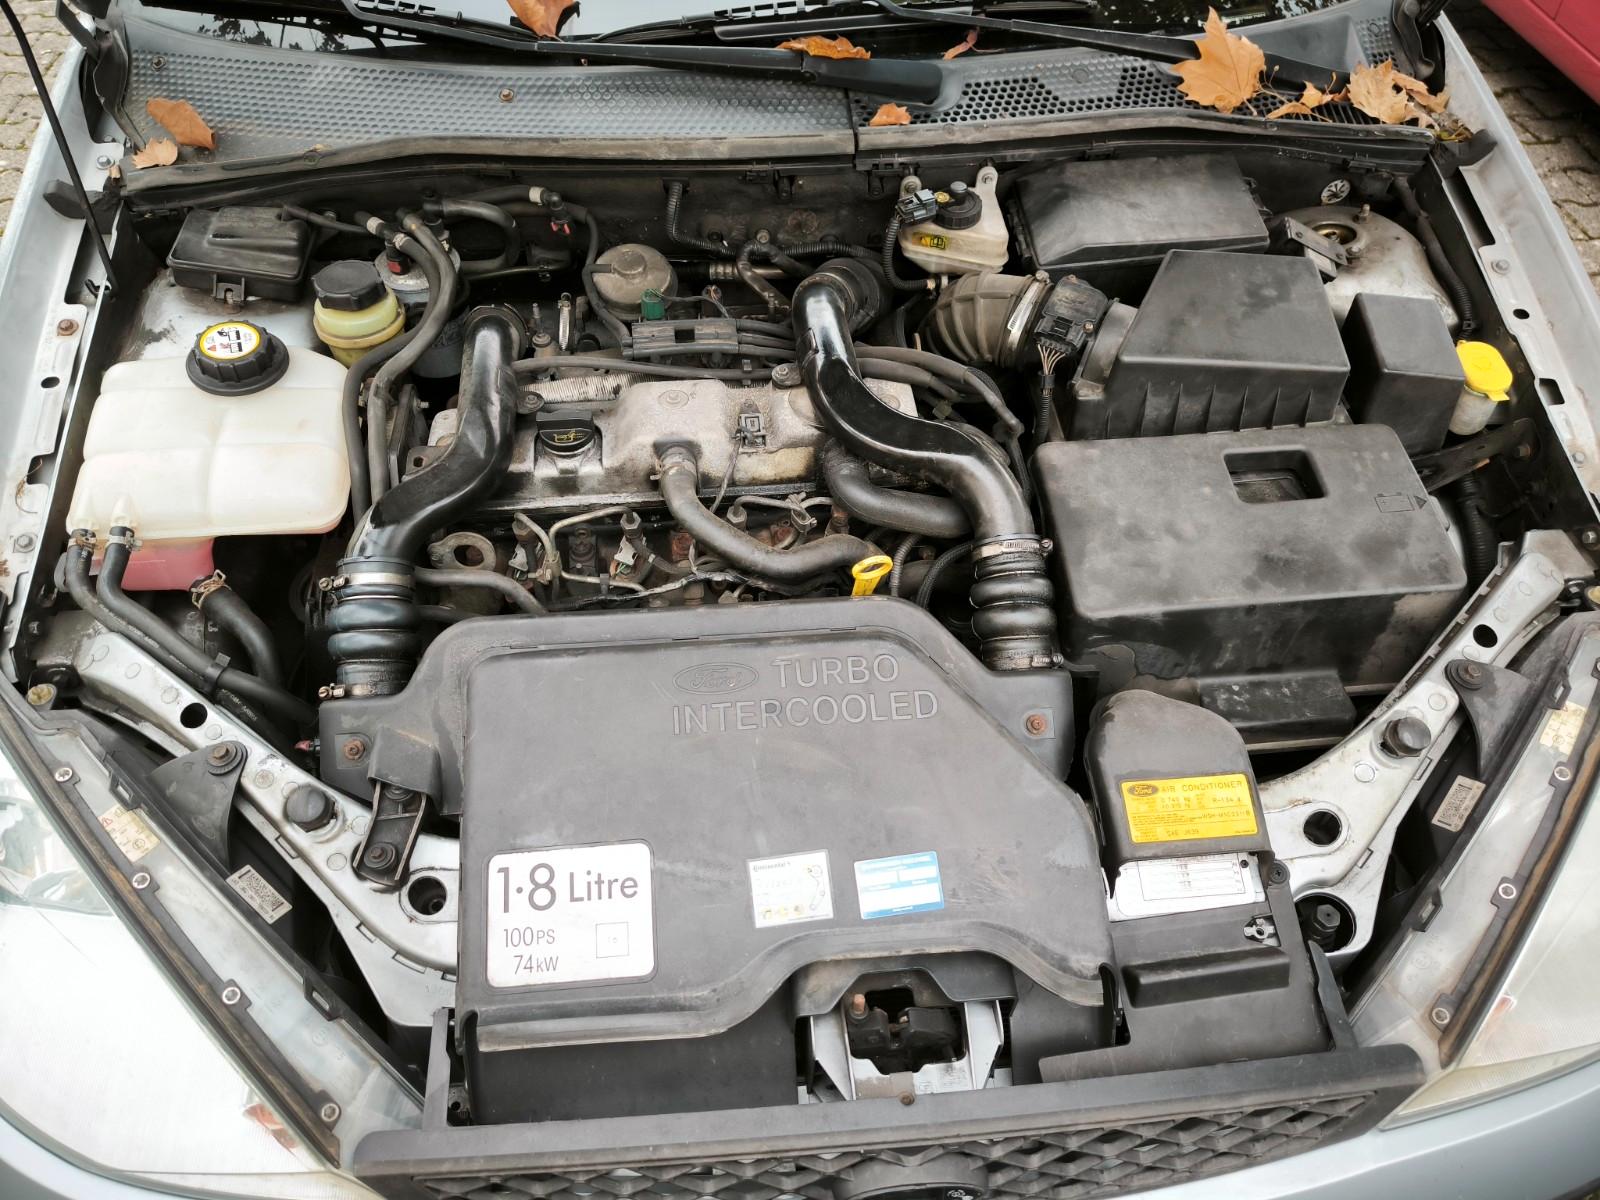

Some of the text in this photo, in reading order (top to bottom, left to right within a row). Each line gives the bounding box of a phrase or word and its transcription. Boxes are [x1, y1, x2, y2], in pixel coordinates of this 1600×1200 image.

[772, 653, 898, 688] TURBO
[672, 689, 938, 735] INTERCOOLED
[1160, 780, 1242, 793] AIR CONDITIONER
[569, 869, 638, 902] Litre
